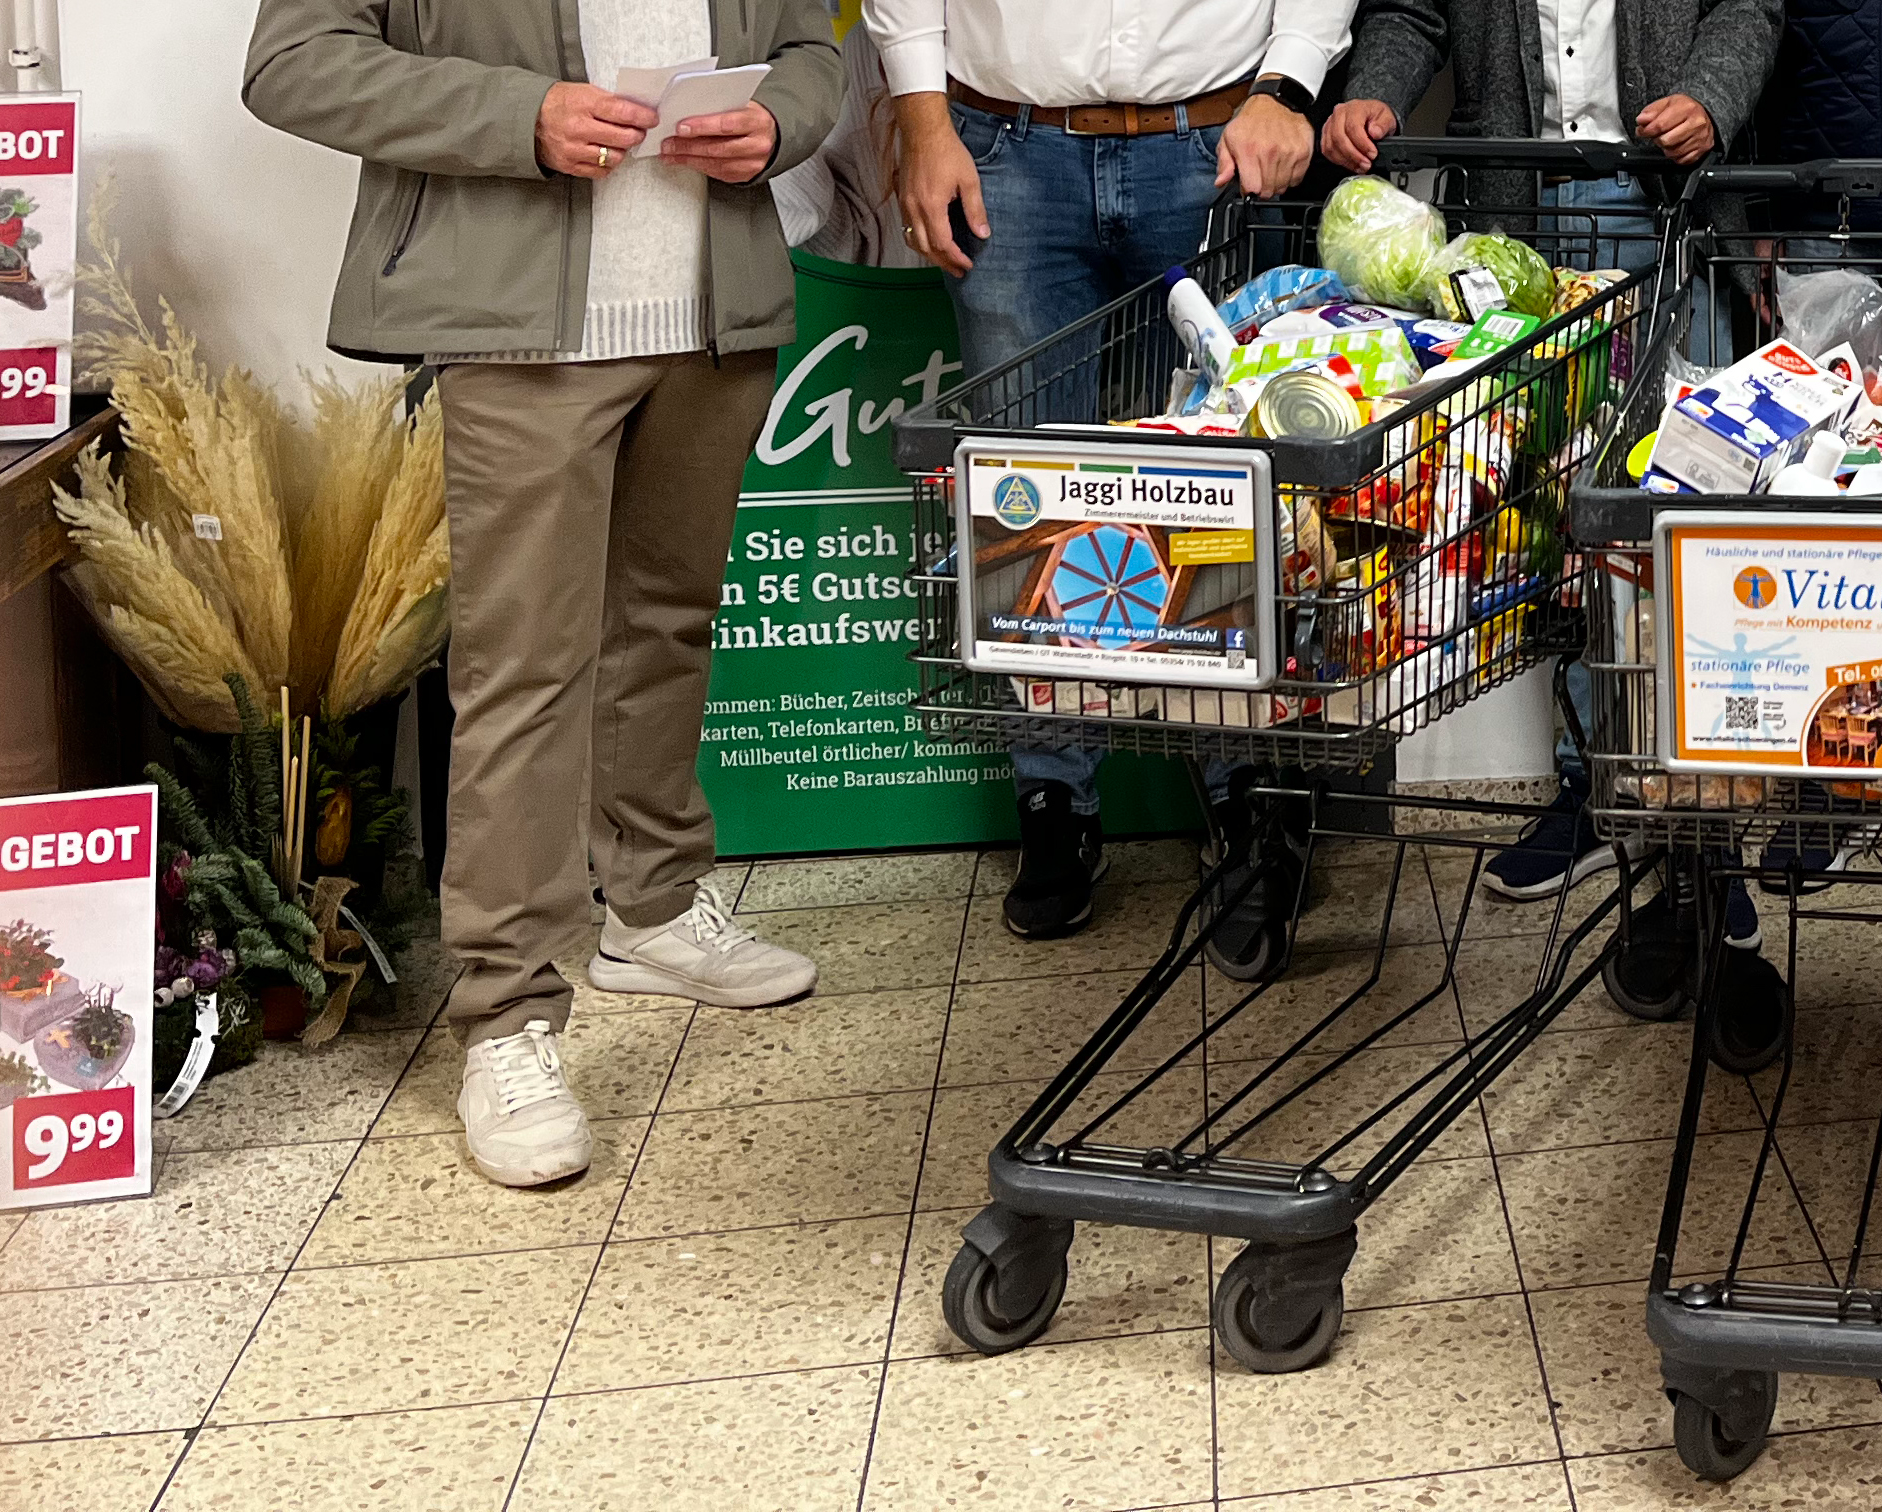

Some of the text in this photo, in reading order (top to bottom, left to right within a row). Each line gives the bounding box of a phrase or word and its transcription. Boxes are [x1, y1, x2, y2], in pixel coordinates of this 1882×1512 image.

[1060, 475, 1234, 506] Jaggi Holzbau
[1161, 513, 1178, 522] und
[745, 528, 804, 562] Sie
[816, 525, 898, 557] sich
[1705, 546, 1759, 559] Häusliche
[1763, 547, 1784, 559] und
[1787, 547, 1844, 561] stationäre
[1847, 548, 1882, 563] Pflege
[758, 573, 801, 605] 5€
[991, 616, 1218, 642] Vom Carport bis zum neuen Dachstuhl
[1786, 616, 1873, 633] Kompetenz
[1691, 659, 1810, 676] stationäre Pflege
[1834, 665, 1865, 684] Tel.
[780, 693, 849, 712] Bücher,
[767, 717, 899, 739] Telefonkarten,
[720, 746, 818, 768] Müllbeutel
[822, 741, 909, 762] örtlicher/
[786, 772, 838, 791] Keine
[842, 766, 978, 788] Barauszahlung
